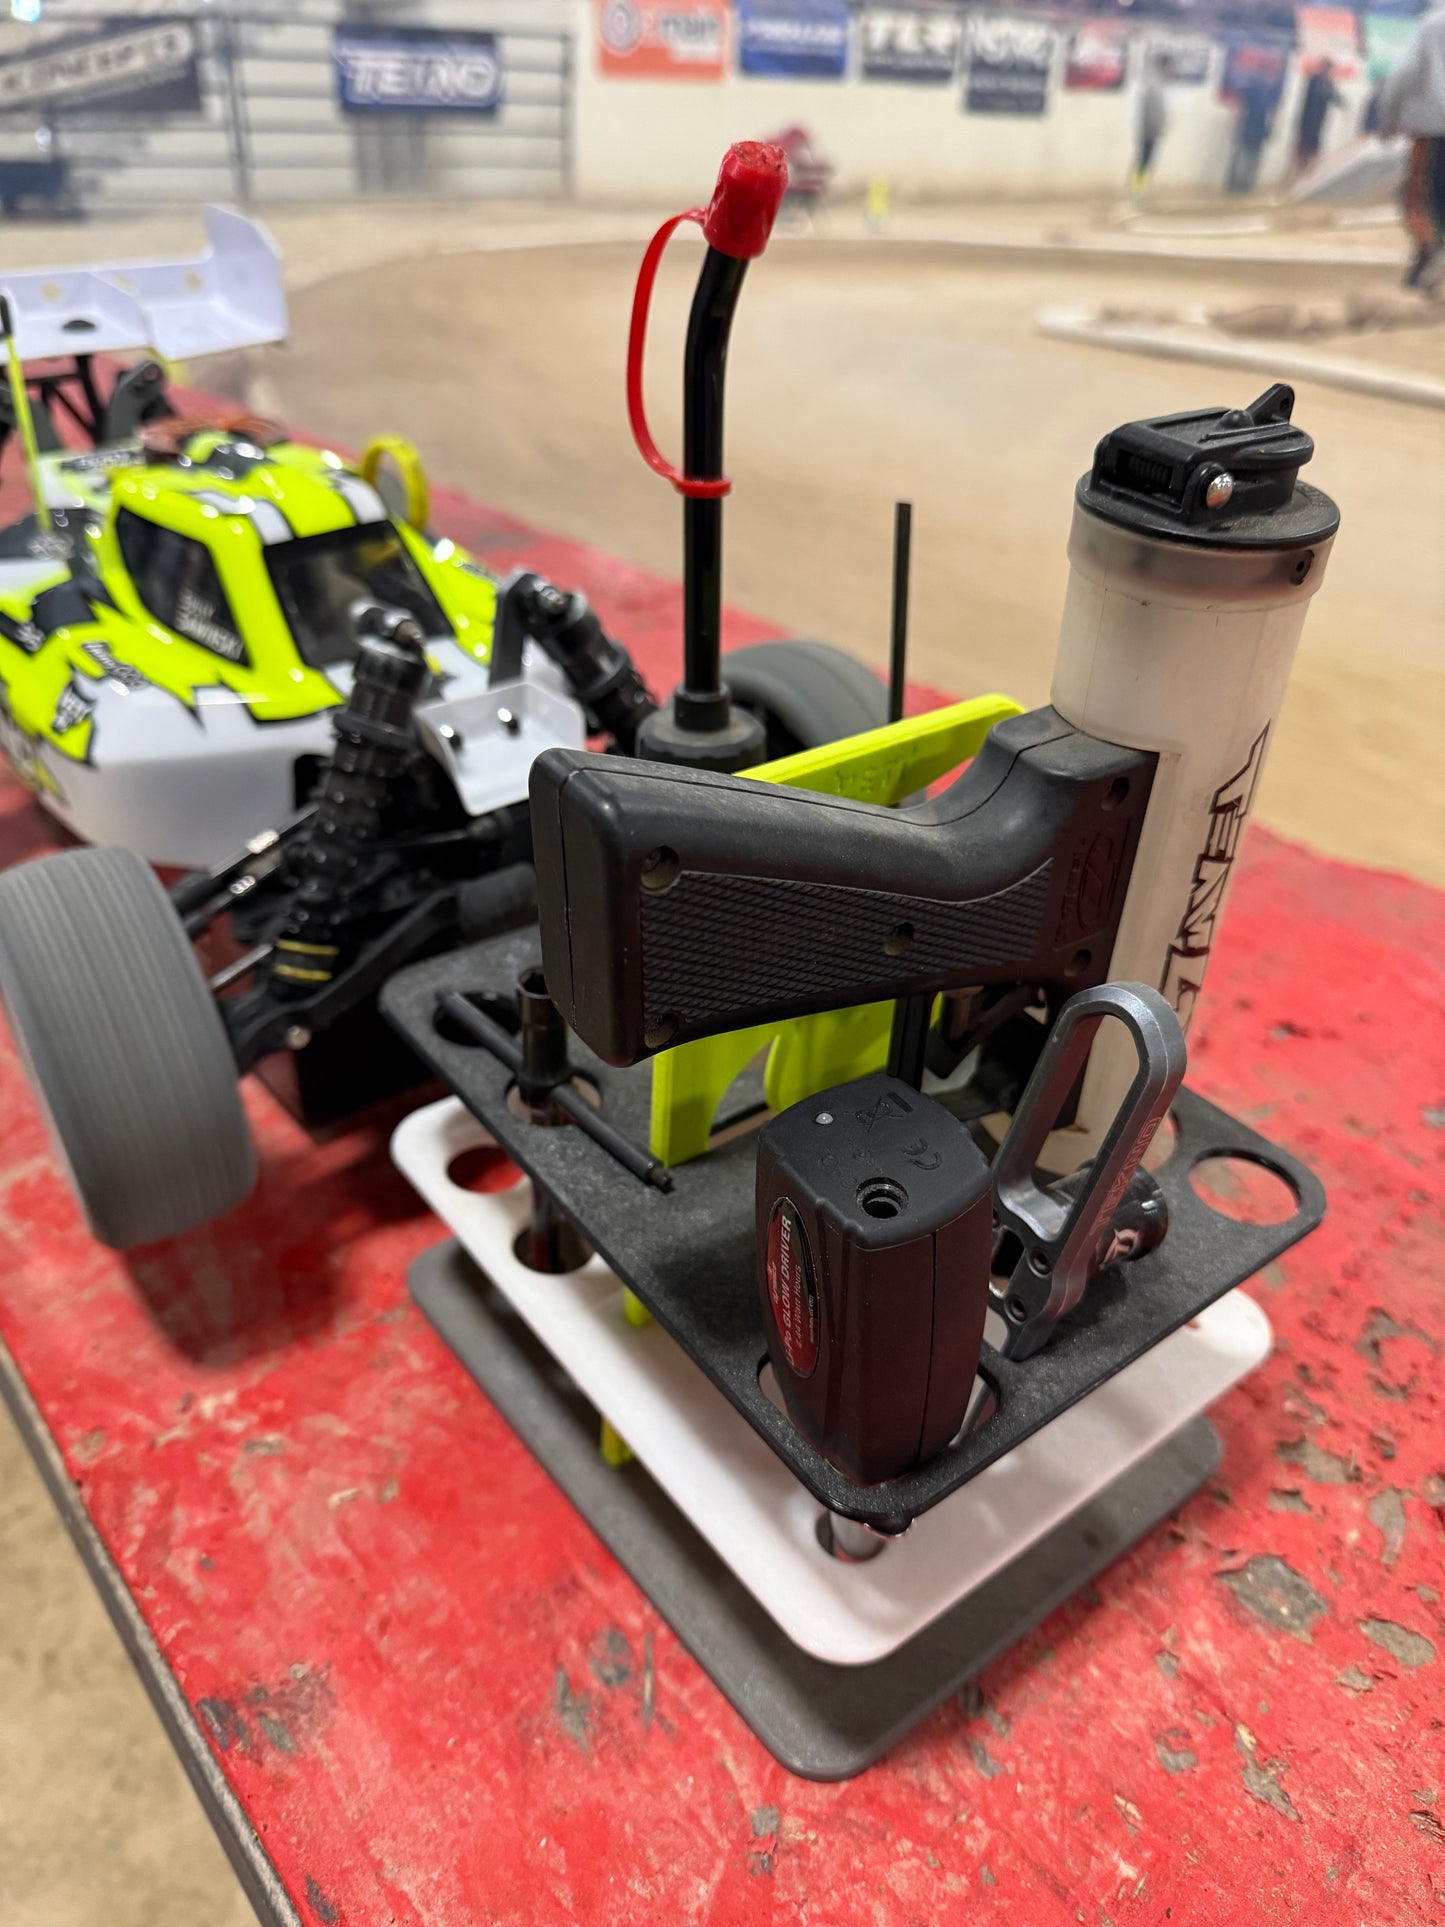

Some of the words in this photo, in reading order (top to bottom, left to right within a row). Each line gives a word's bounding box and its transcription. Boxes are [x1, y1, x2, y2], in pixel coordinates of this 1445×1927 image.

[780, 1215, 792, 1281] DRIVER
[781, 1278, 792, 1328] GLOW
[793, 1264, 802, 1297] Hours
